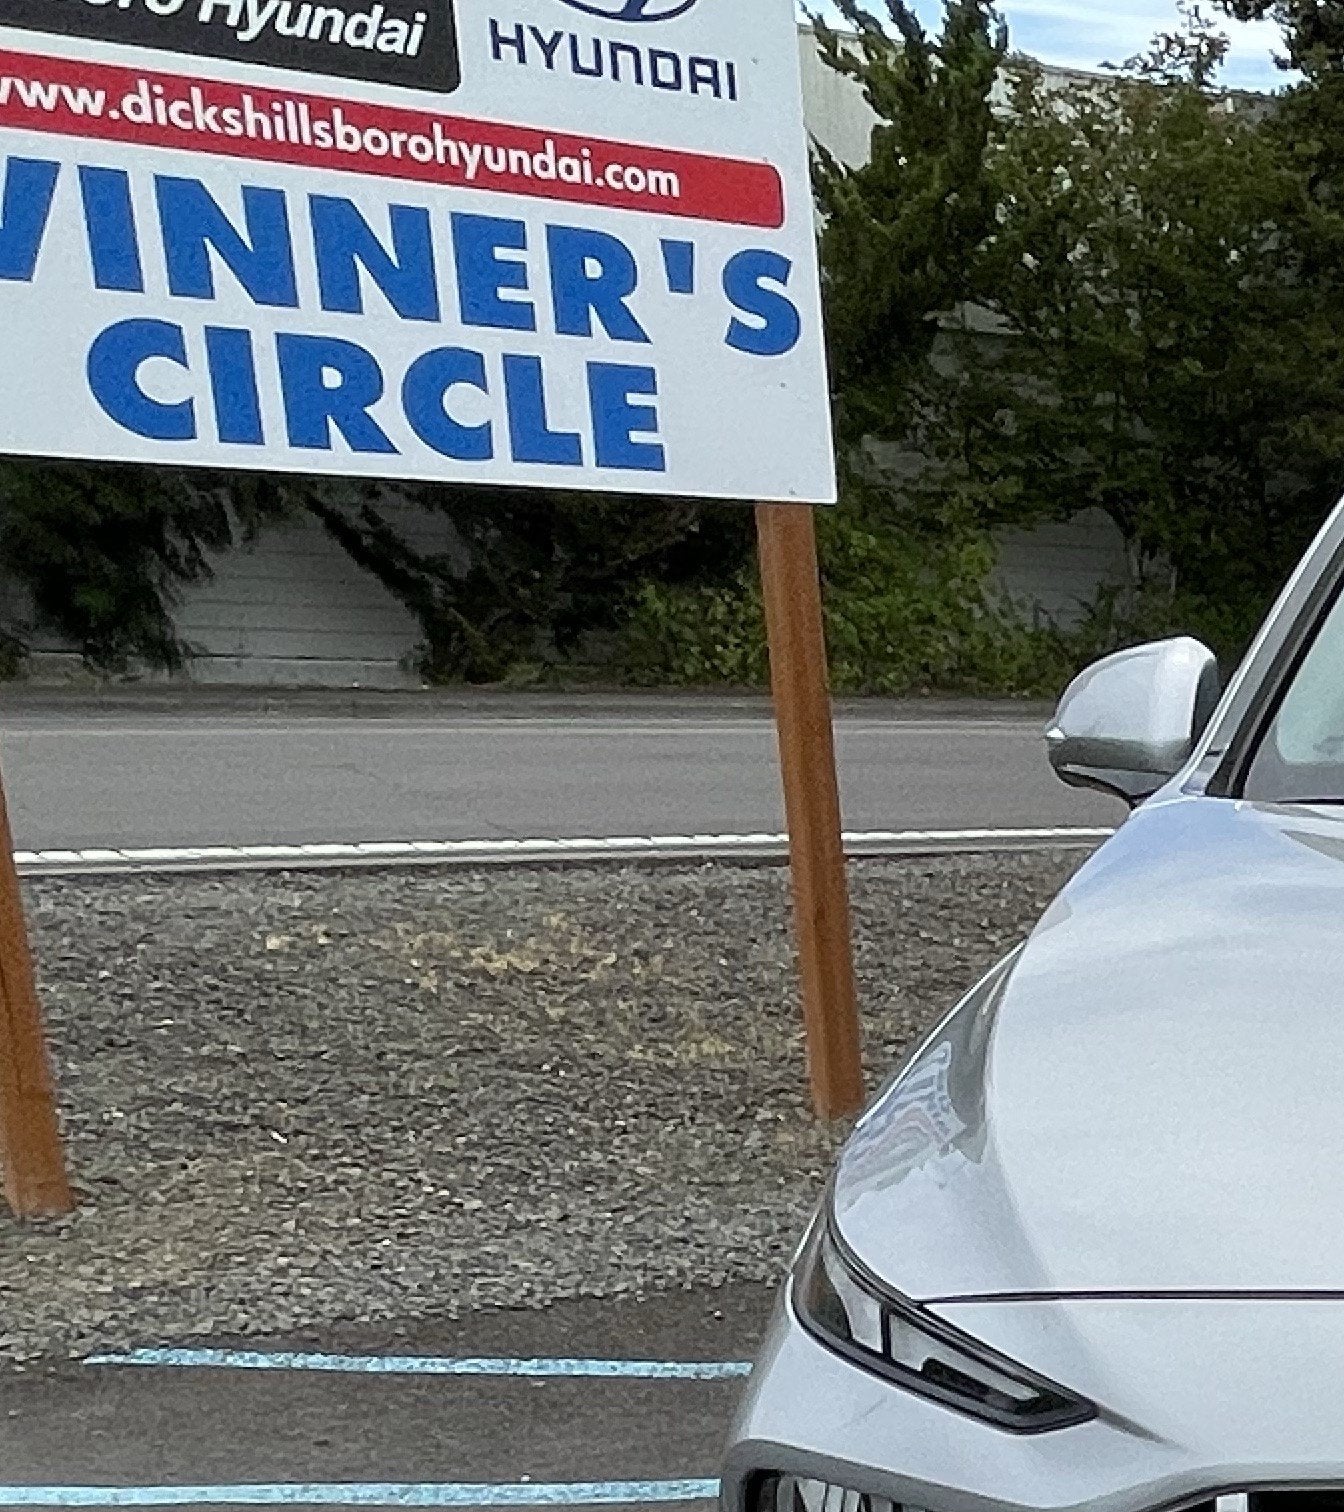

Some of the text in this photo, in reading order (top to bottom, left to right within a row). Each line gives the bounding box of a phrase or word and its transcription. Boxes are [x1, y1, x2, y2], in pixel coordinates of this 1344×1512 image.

[489, 18, 738, 101] HYUNDAI
[0, 76, 681, 198] ww.dickshillsborohyundai.com
[86, 318, 667, 473] CIRCLE
